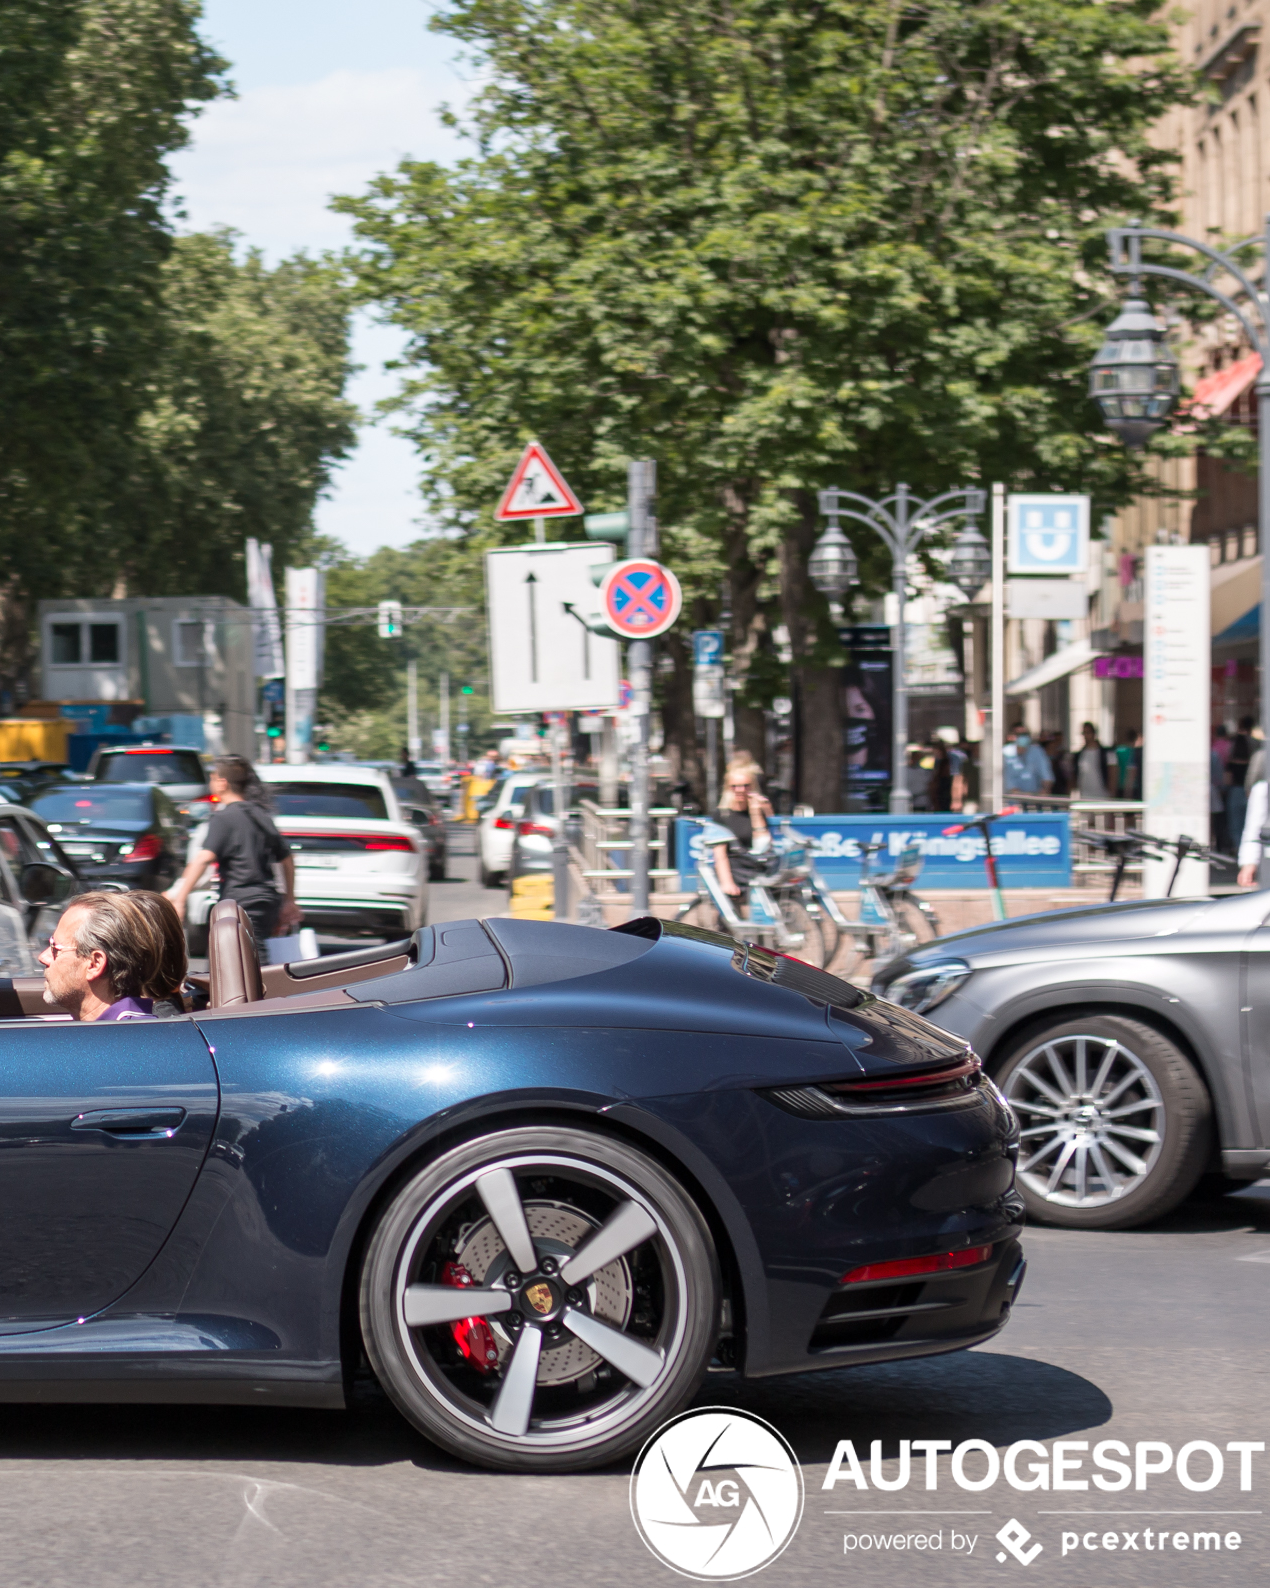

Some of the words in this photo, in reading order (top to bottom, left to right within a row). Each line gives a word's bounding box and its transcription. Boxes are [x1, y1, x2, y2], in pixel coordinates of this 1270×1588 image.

[1025, 510, 1072, 561] U
[698, 635, 720, 662] P
[887, 829, 1062, 862] Königsallee
